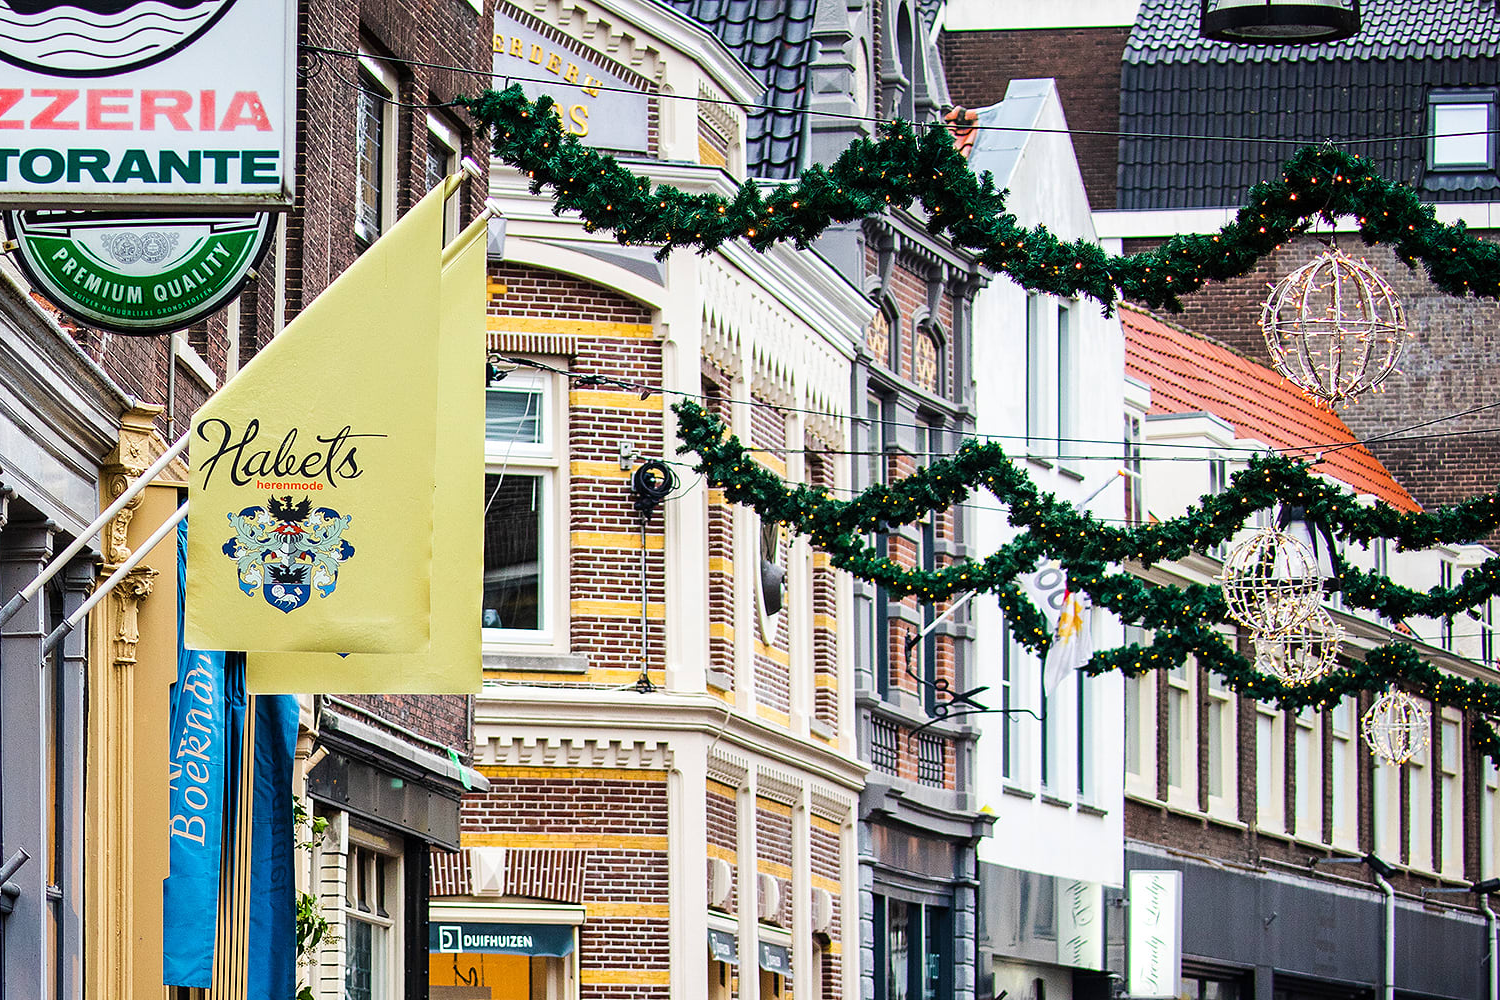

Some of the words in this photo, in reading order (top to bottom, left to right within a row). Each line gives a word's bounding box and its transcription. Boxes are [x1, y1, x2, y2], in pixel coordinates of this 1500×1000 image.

[52, 247, 143, 304] PREMIUM
[153, 241, 232, 302] QUALITY
[72, 290, 100, 309] ZUIVER
[101, 305, 153, 317] NATUURLIJKE
[157, 287, 213, 315] GRONDSTOFFEN
[197, 418, 388, 491] Habets
[257, 480, 324, 491] herenmode
[463, 934, 533, 948] DUIFHUIZEN
[1138, 935, 1167, 995] Trendy
